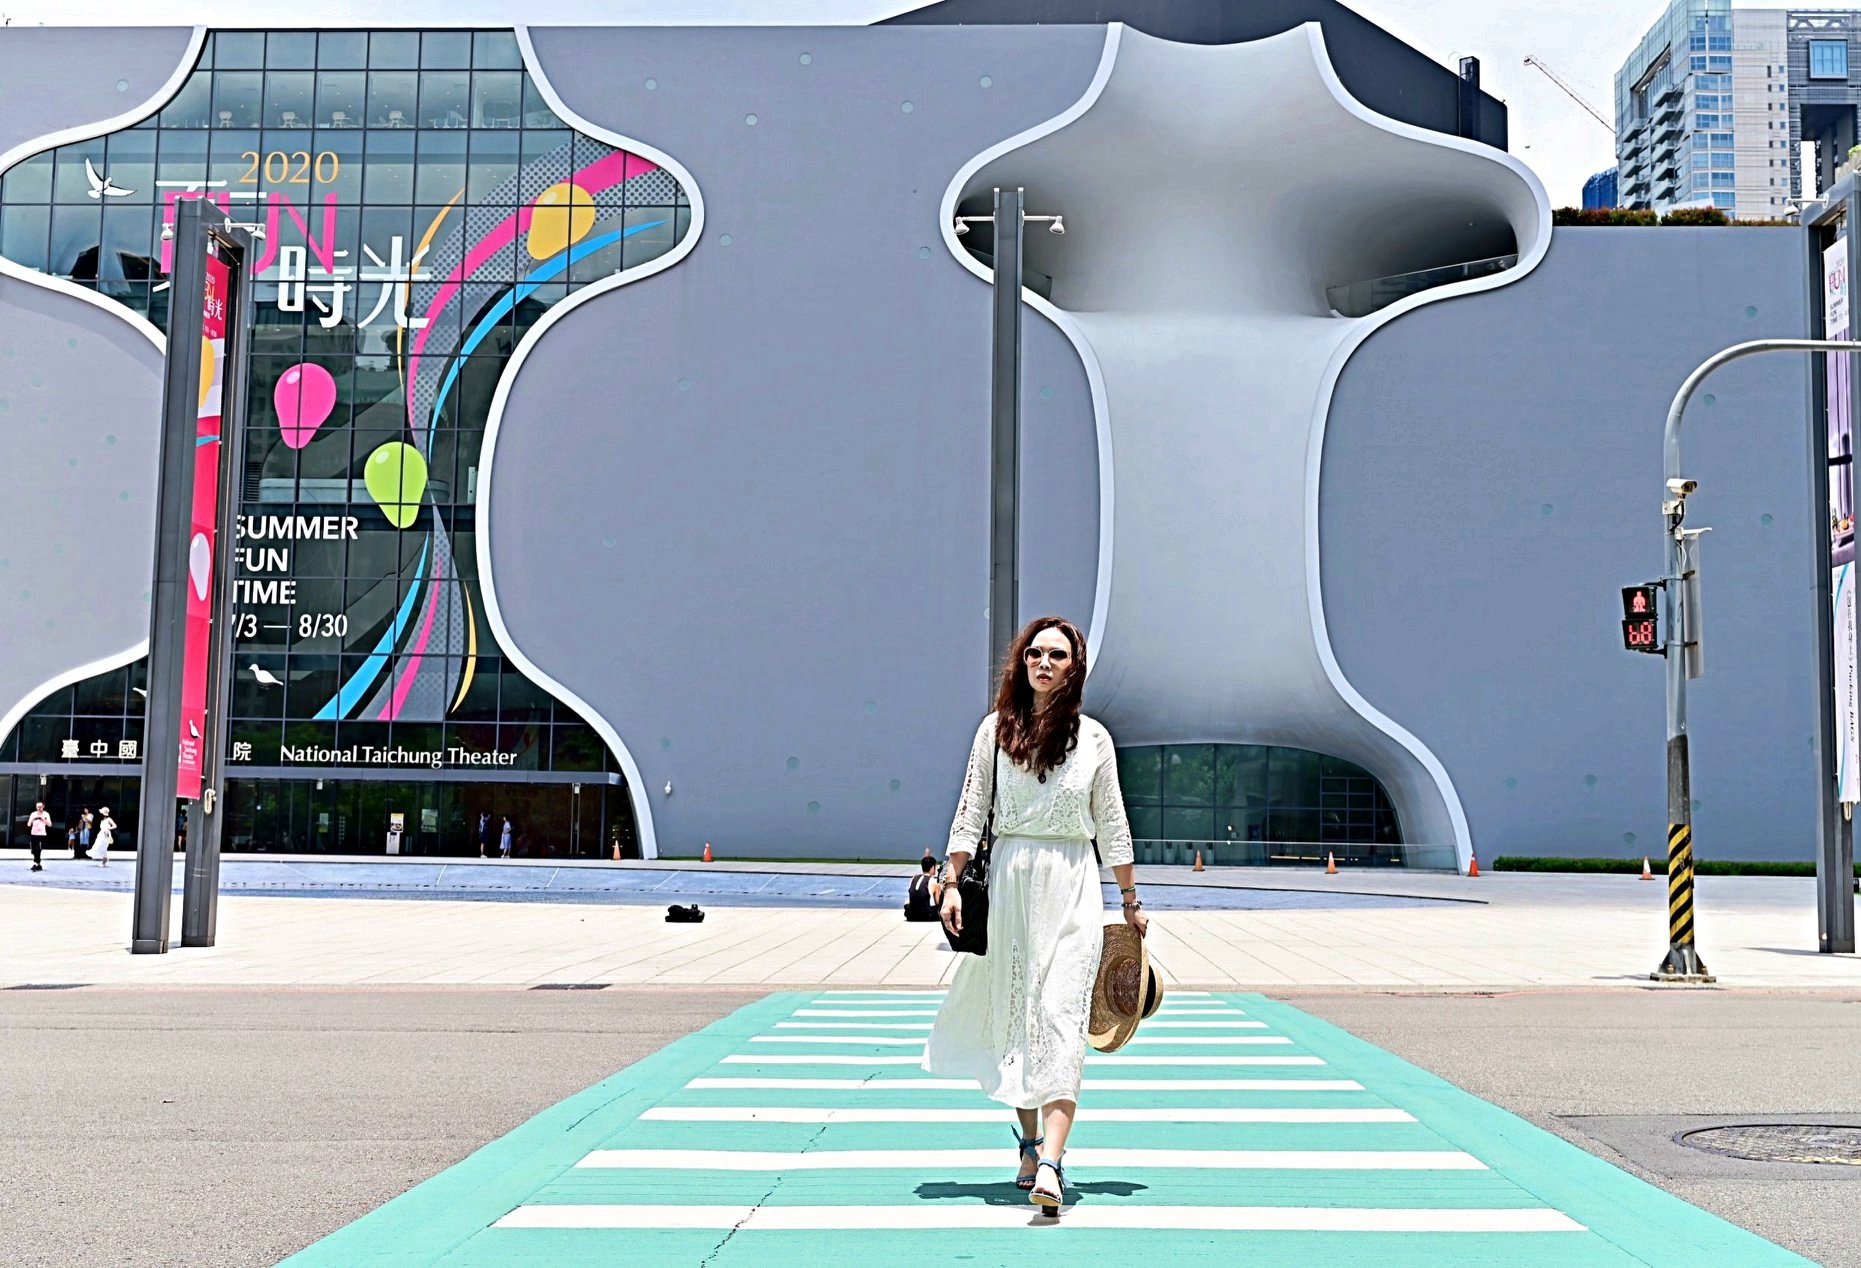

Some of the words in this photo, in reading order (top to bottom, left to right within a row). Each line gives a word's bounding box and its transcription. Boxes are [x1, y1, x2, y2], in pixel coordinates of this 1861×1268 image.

[239, 151, 340, 184] 2020
[277, 236, 431, 329] 時光
[235, 514, 359, 540] SUMMER
[231, 613, 258, 638] /3
[298, 613, 348, 638] 8/30
[1628, 621, 1652, 645] 68
[280, 745, 357, 763] National
[361, 746, 443, 769] Taichung
[447, 747, 518, 765] Theater
